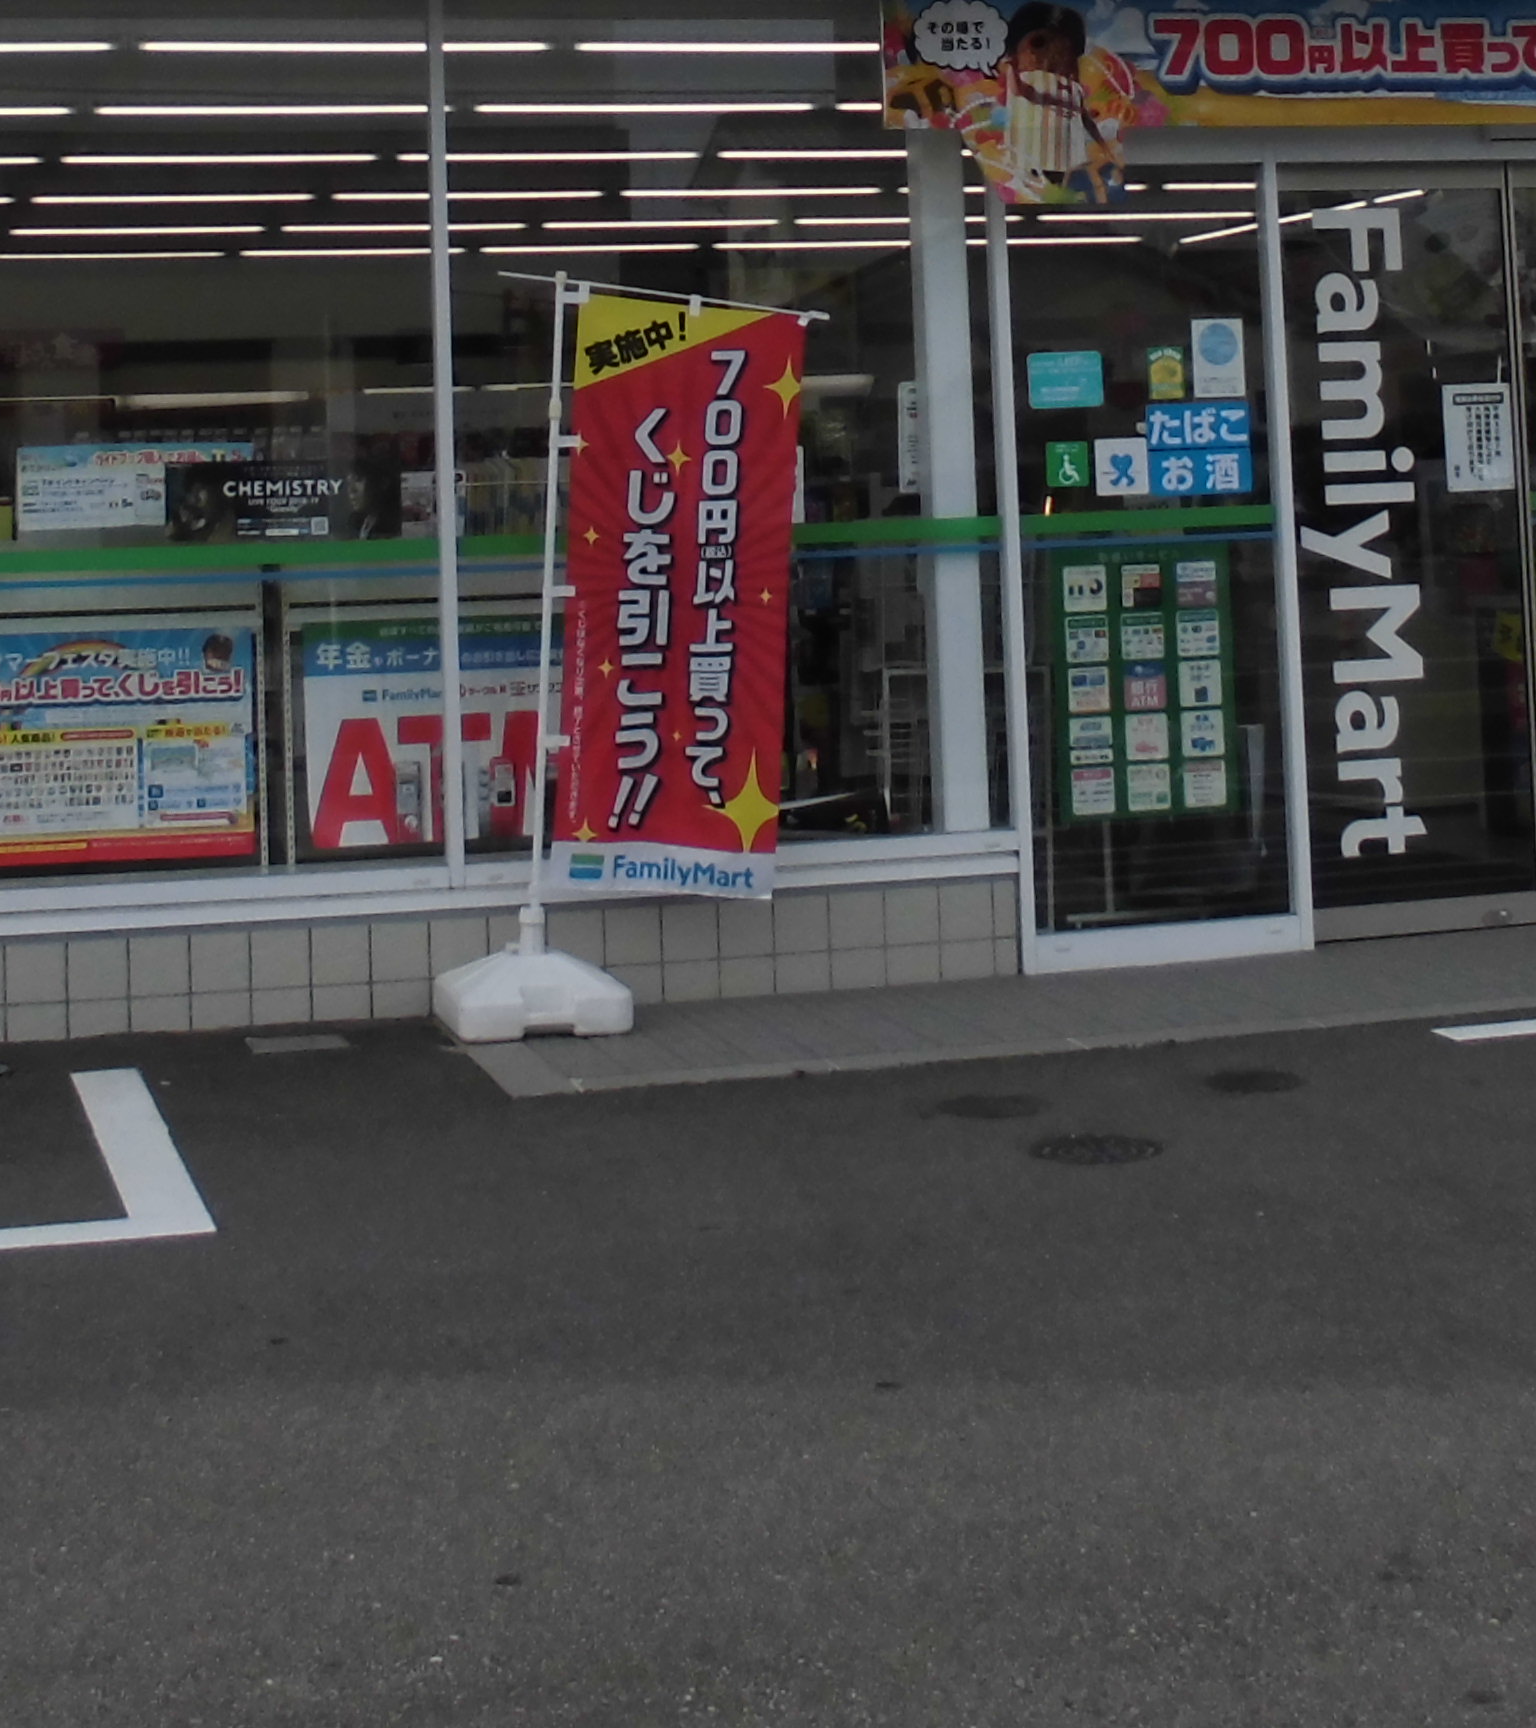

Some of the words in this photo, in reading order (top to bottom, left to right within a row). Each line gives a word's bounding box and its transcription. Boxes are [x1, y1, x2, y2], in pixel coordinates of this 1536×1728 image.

[584, 310, 688, 375] 実施中!
[1148, 407, 1249, 445] たばこ
[222, 478, 344, 498] CHEMISTRY
[1161, 452, 1240, 492] お酒
[1300, 207, 1428, 859] FamilyMart
[381, 688, 443, 702] FamilyMar
[612, 852, 754, 890] FamilyMart
